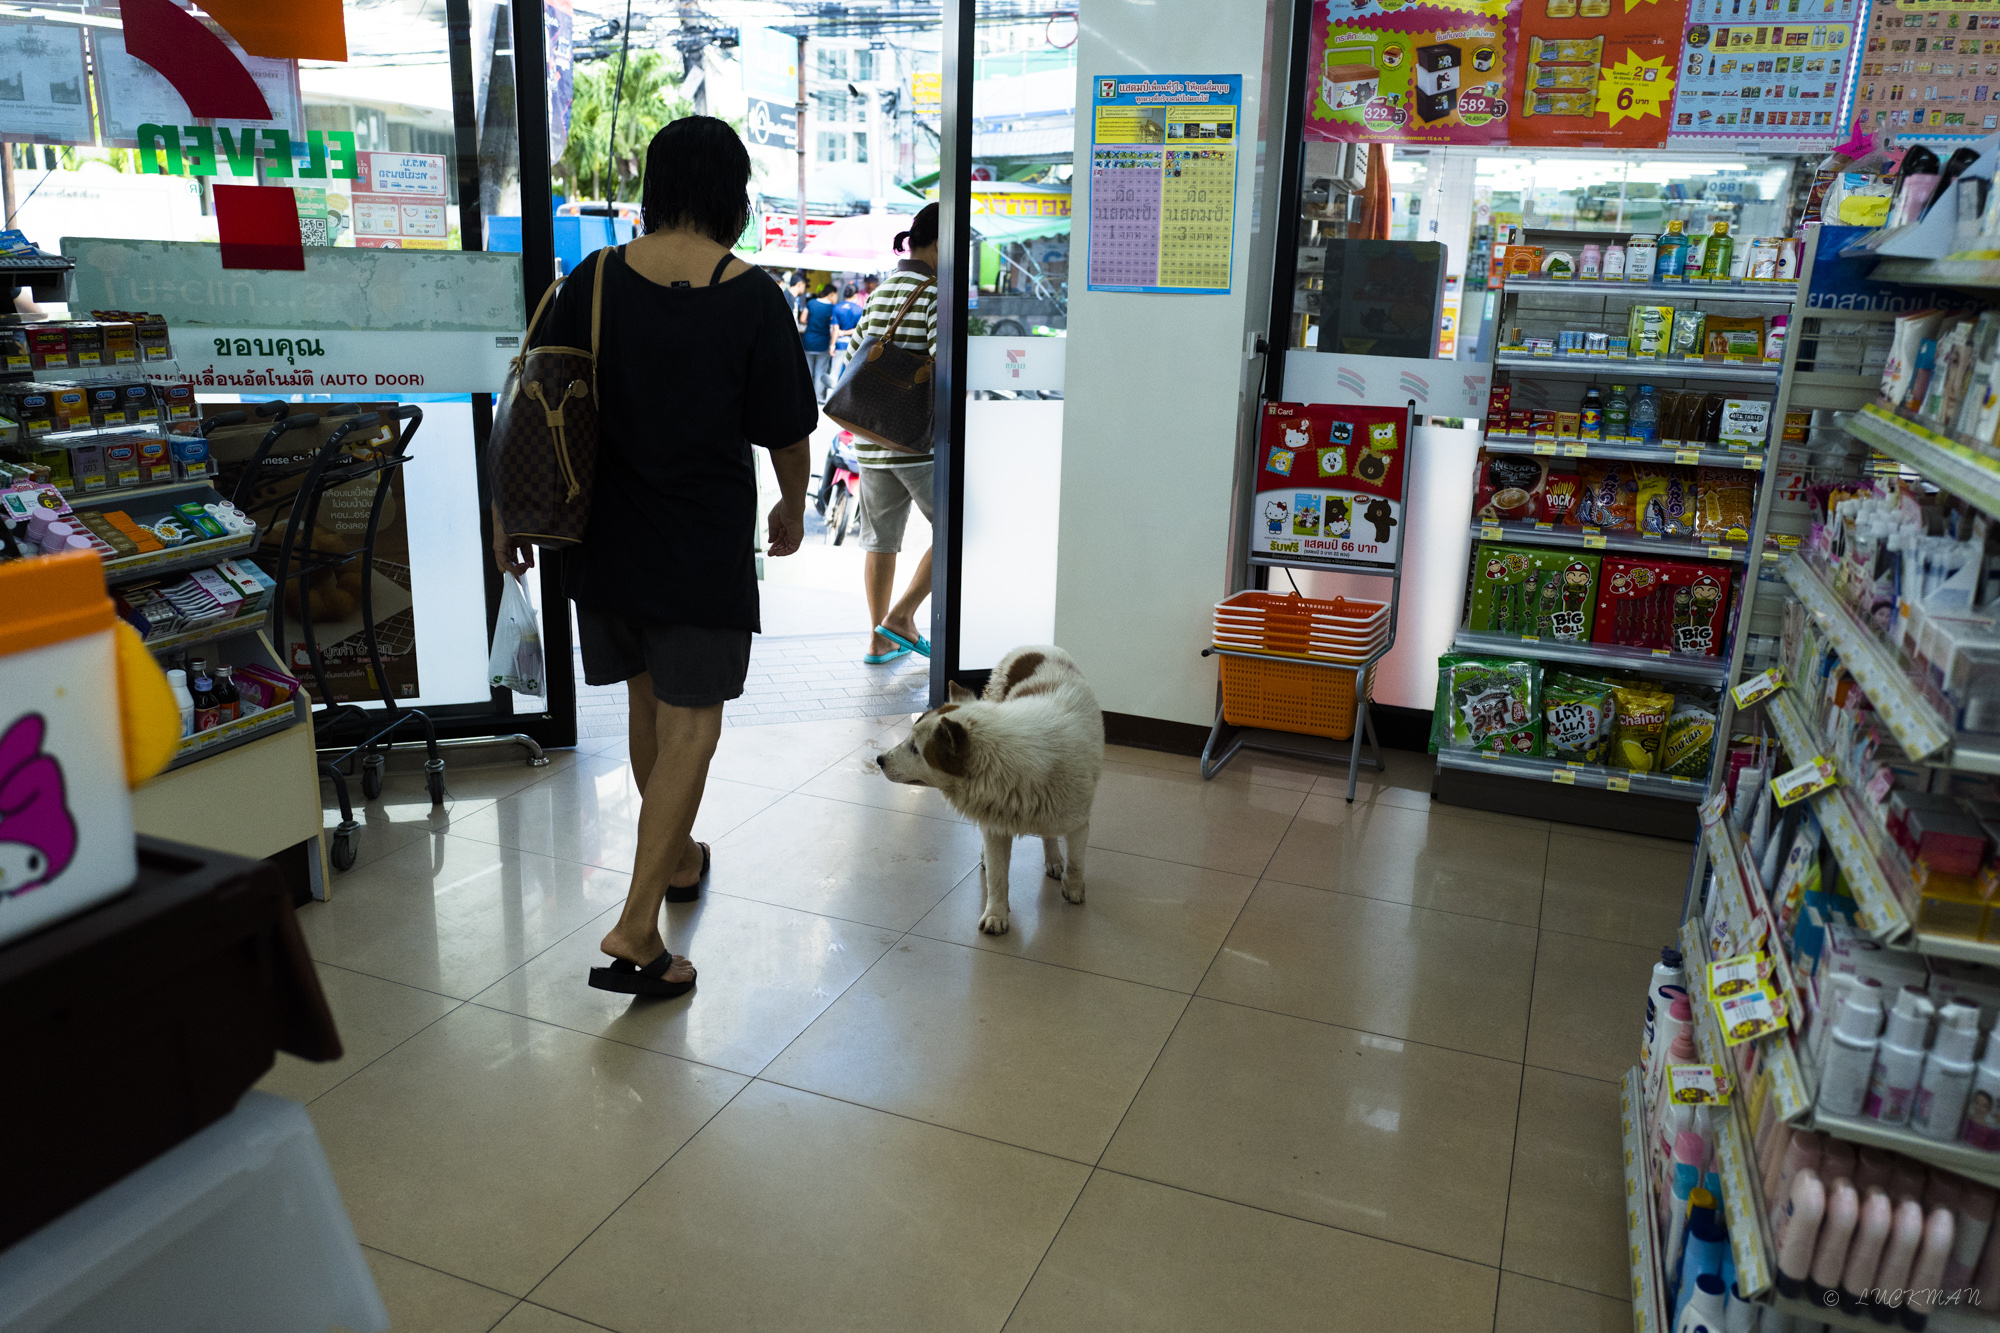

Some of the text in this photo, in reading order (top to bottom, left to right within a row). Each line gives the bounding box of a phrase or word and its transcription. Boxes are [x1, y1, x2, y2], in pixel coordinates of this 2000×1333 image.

[1691, 33, 1699, 43] 6
[1634, 66, 1643, 77] 2
[1617, 87, 1634, 110] 6
[1459, 99, 1486, 111] 589
[1365, 108, 1388, 119] 329
[0, 257, 66, 267] atteries
[214, 337, 325, 365] ขอบคุณ
[321, 374, 367, 387] (AUTO
[375, 374, 424, 387] DOOR)
[128, 389, 146, 397] durex
[171, 389, 189, 397] durex
[25, 398, 45, 406] durex
[62, 395, 81, 403] durex
[113, 449, 131, 457] durex
[186, 445, 203, 453] durex
[83, 464, 98, 473] 003
[1600, 464, 1624, 506] TARO
[1667, 470, 1685, 517] TARO
[44, 499, 53, 508] 6
[1270, 539, 1378, 554] รับฟรี แสตมป์ 66 บาท
[1555, 625, 1582, 634] ROLL
[1682, 640, 1710, 648] ROLL
[1619, 711, 1666, 726] Chainoi
[1667, 728, 1704, 758] Durian
